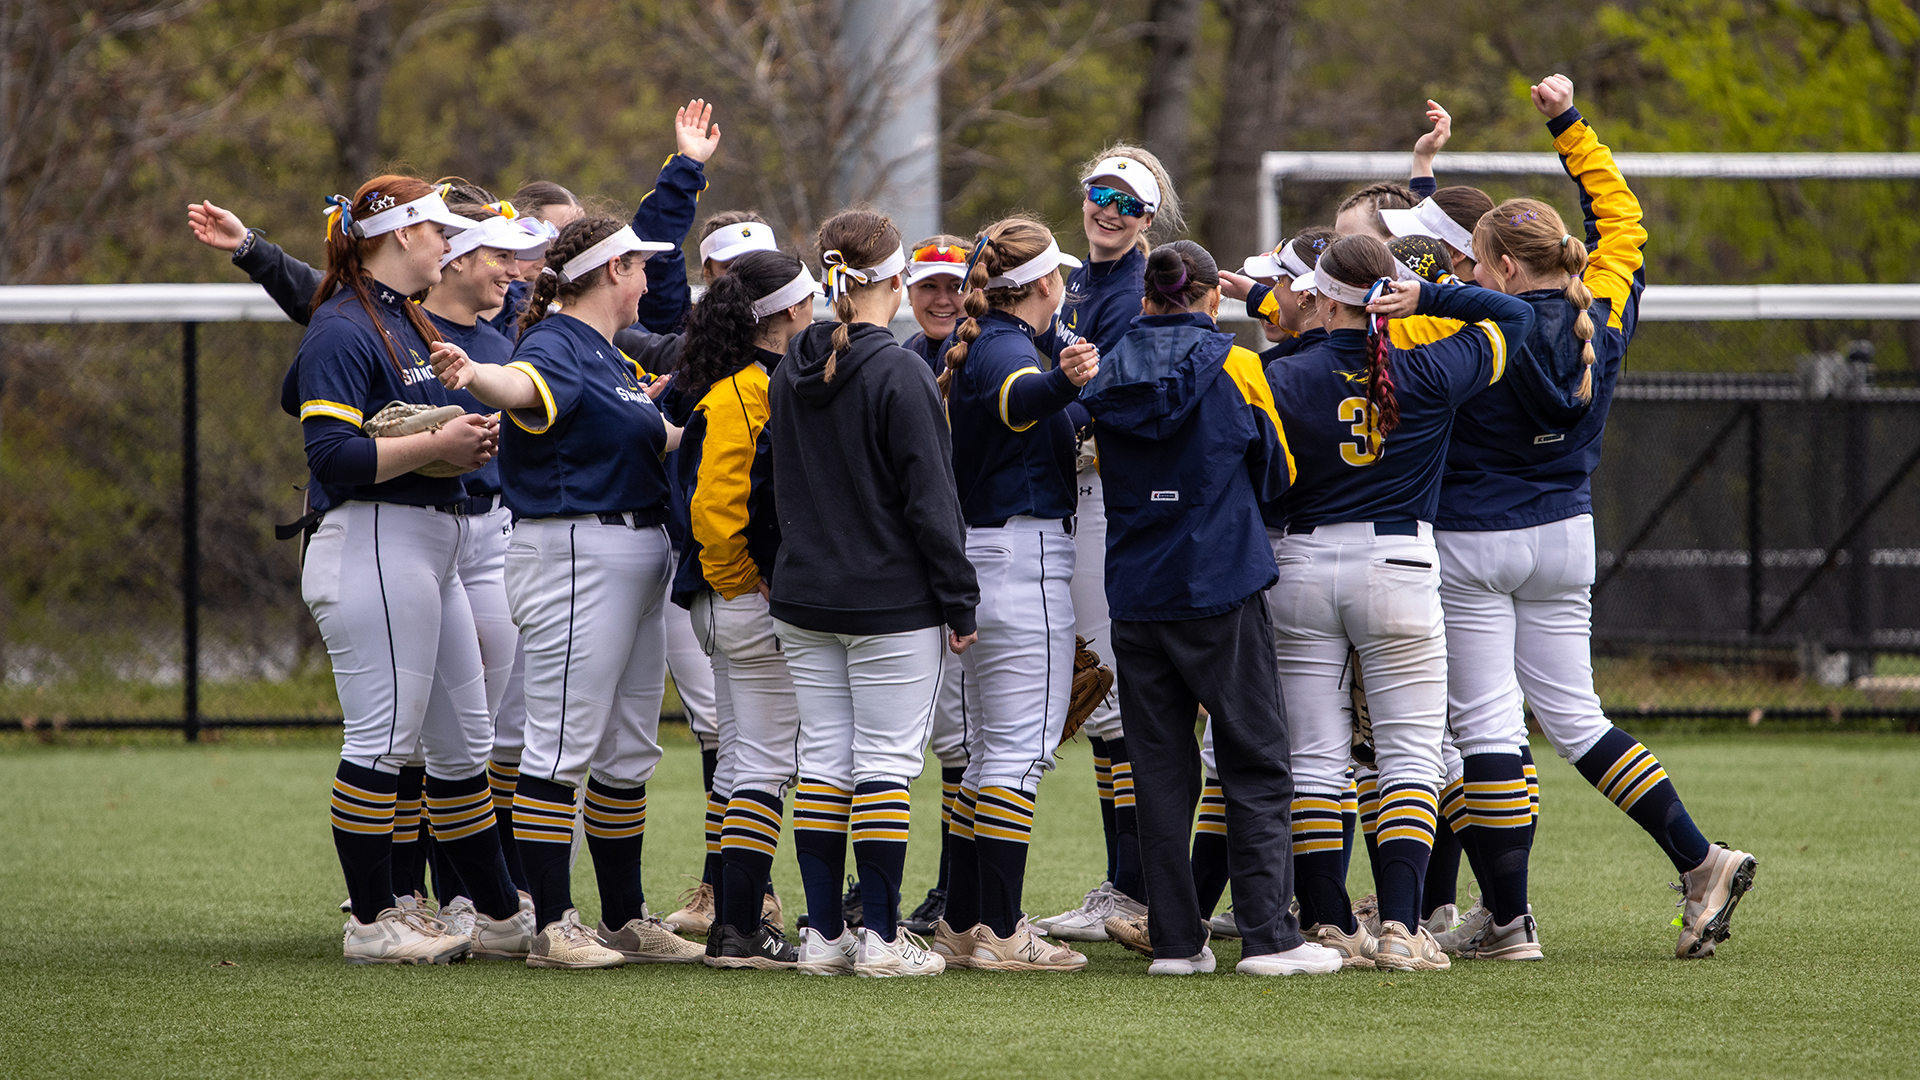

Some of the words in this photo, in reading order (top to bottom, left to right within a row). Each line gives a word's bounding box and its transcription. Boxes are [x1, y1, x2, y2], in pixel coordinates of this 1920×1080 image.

[403, 364, 436, 386] SIMMO
[615, 387, 653, 404] SIMMO
[1338, 396, 1385, 467] 3
